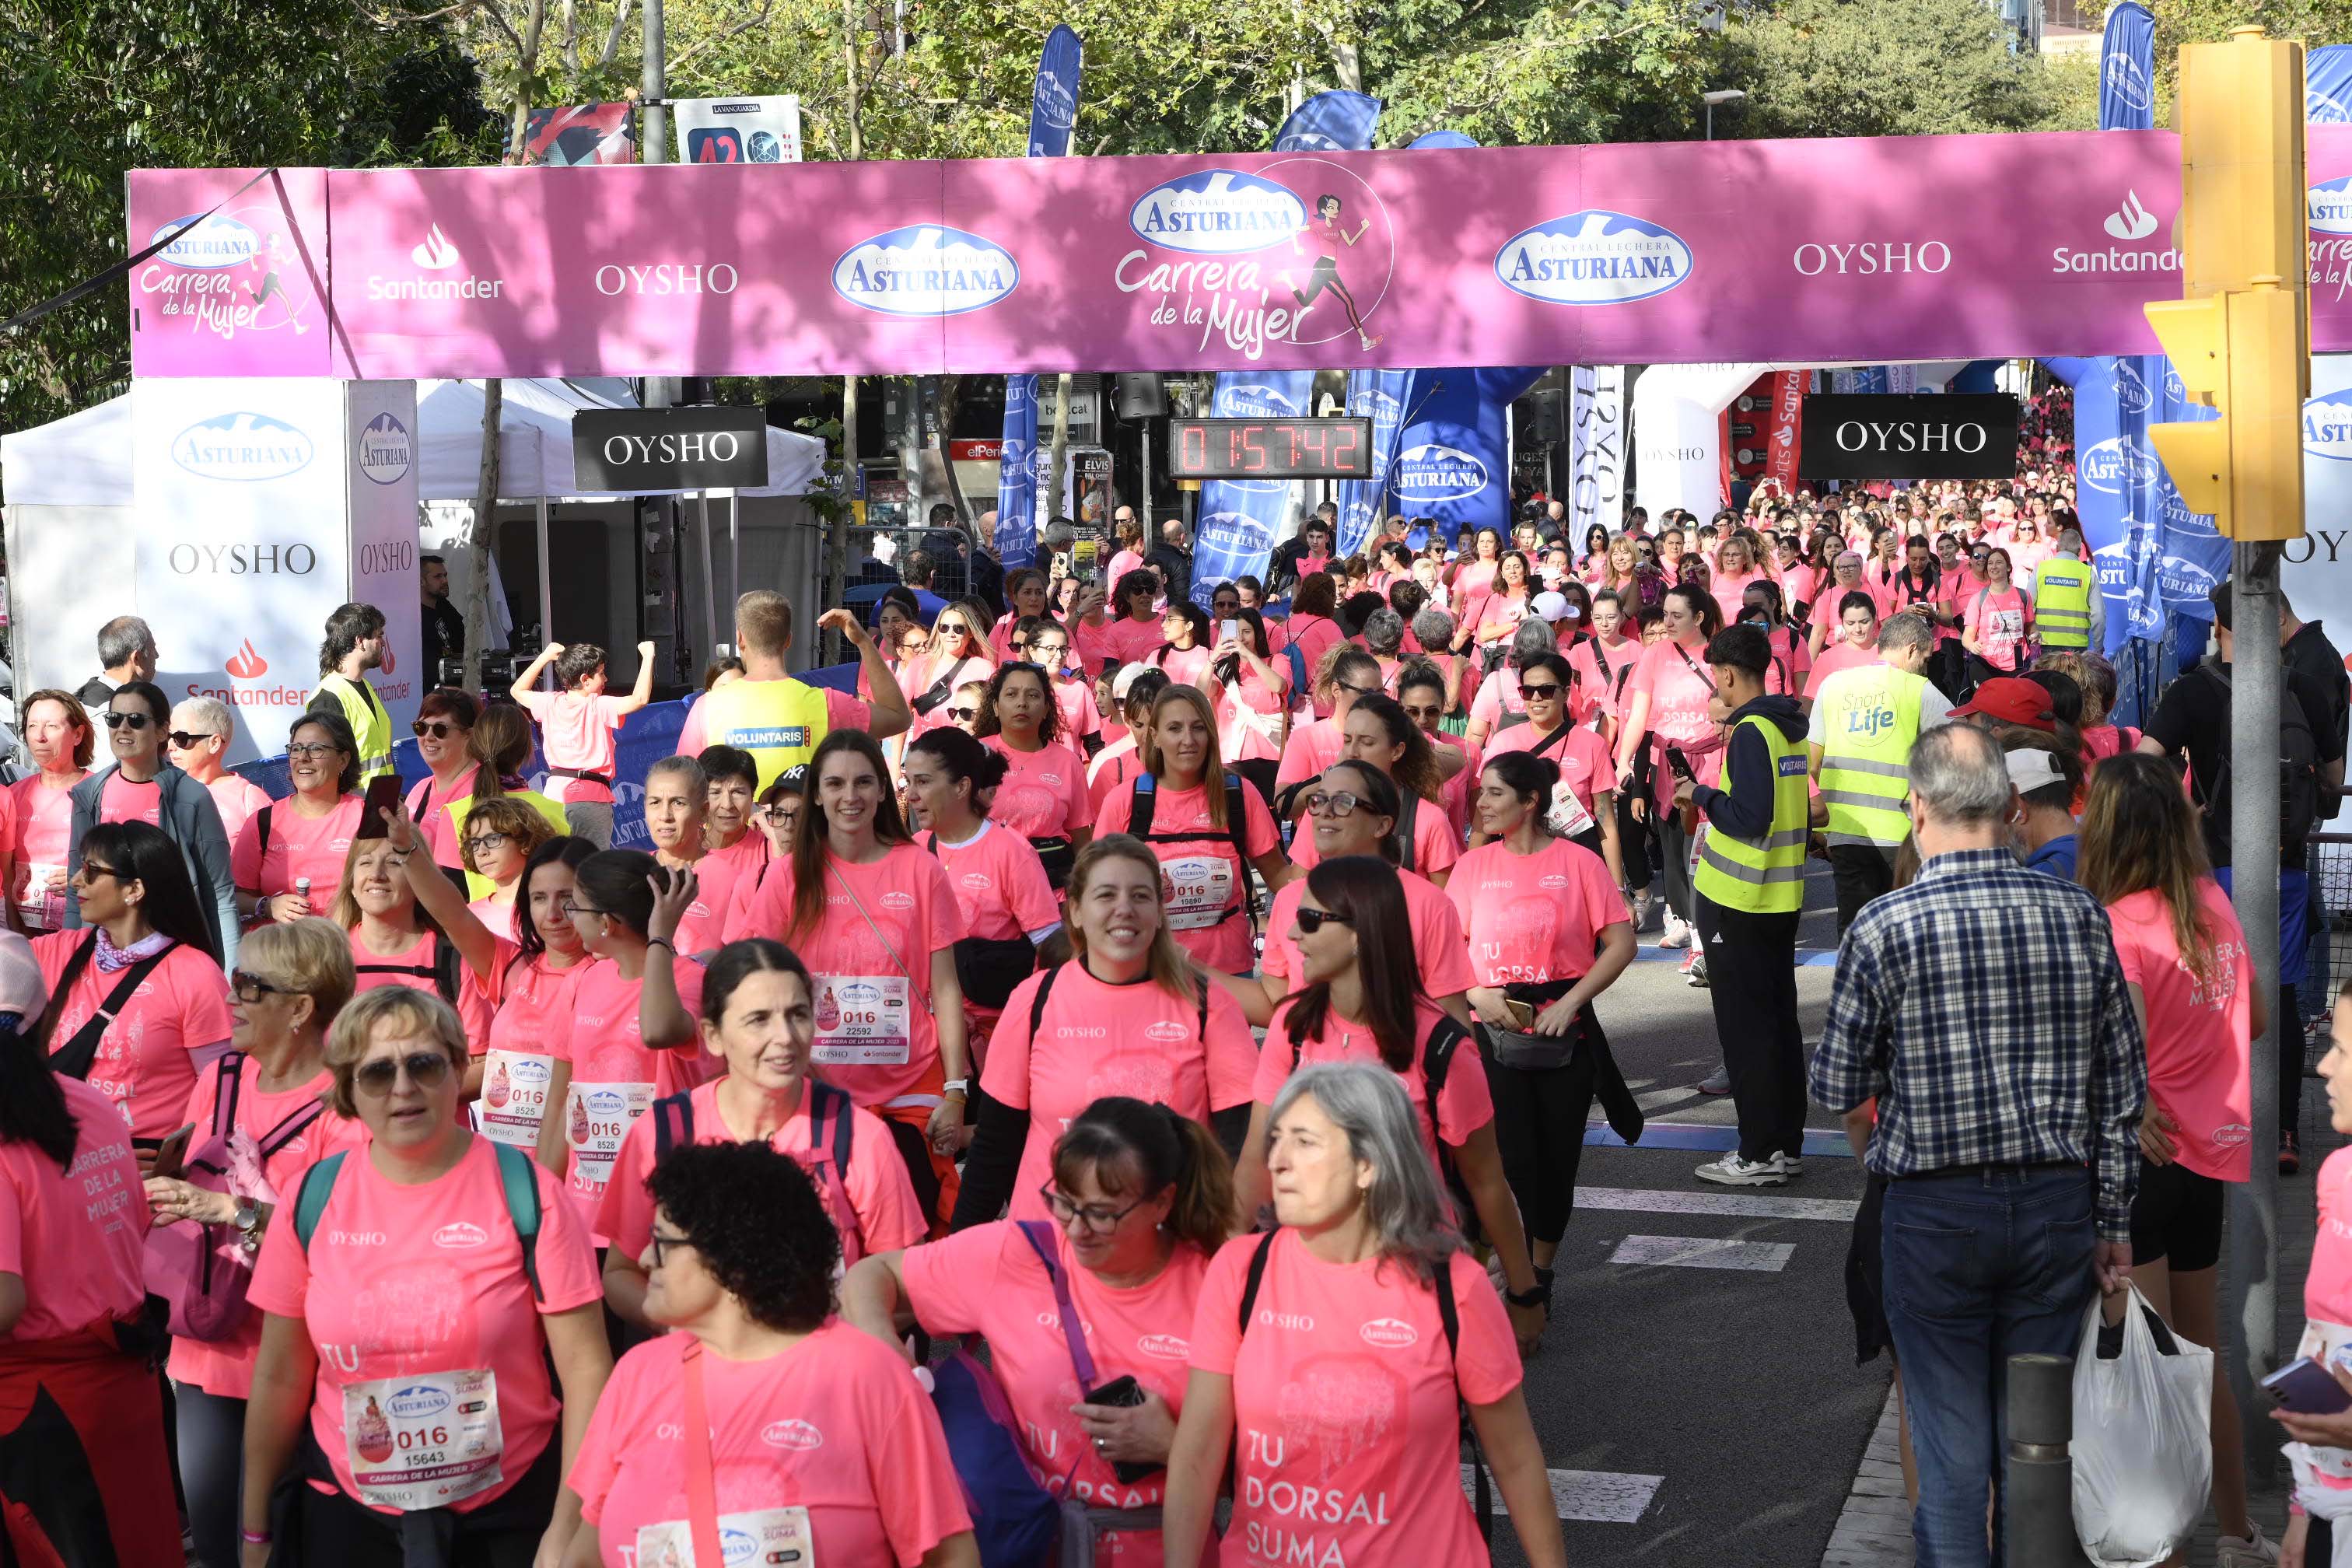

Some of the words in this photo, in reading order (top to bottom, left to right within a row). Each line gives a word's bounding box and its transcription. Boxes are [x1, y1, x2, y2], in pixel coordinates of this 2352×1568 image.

[1143, 201, 1293, 233] ASTURIANA
[1540, 243, 1600, 253] CENTRAL
[1606, 242, 1672, 251] LECHERA
[1793, 240, 1951, 275] OYSHO
[847, 258, 1006, 292] ASTURIANA
[1114, 249, 1260, 292] Carrera
[1508, 247, 1678, 282] ASTURIANA
[140, 264, 232, 293] Carrera
[367, 275, 503, 301] Santander
[594, 263, 738, 296] OYSHO
[163, 292, 180, 315] de
[182, 292, 196, 316] la
[193, 291, 267, 340] Mujer
[1150, 295, 1178, 325] de
[1183, 293, 1203, 325] la
[1199, 286, 1315, 361] Mujer
[1182, 425, 1356, 470] 01:57:42
[1836, 421, 1986, 453] OYSHO
[183, 437, 303, 464] ASTURIANA
[362, 446, 408, 467] ASTURIANA
[604, 432, 739, 465] OYSHO
[1644, 446, 1704, 461] OYSHO
[1085, 460, 1109, 471] ELVIS
[1437, 463, 1478, 471] LECHERA
[1393, 467, 1482, 489] ASTURIANA
[1199, 522, 1270, 551] ASTURIANA
[169, 543, 317, 575] OYSHO
[360, 540, 412, 576] OYSHO
[1843, 690, 1886, 710] Sport
[1848, 705, 1895, 737] Life
[726, 732, 802, 745] VOLUNTARIS
[271, 843, 303, 852] OYSHO
[1178, 885, 1205, 897] 016
[1181, 897, 1202, 905] 19890
[1481, 941, 1500, 961] TU
[842, 991, 878, 999] ASTURIANA
[843, 1011, 876, 1024] 016
[845, 1027, 872, 1036] 22592
[1056, 1027, 1107, 1040] OYSHO
[514, 1068, 548, 1079] ASTURIANA
[512, 1089, 543, 1104] 016
[589, 1098, 623, 1109] ASTURIANA
[515, 1106, 536, 1115] 8525
[488, 1127, 514, 1138] OYSHO
[591, 1122, 621, 1136] 016
[597, 1141, 615, 1150] 8528
[83, 1174, 104, 1197] DE
[105, 1170, 123, 1190] LA
[86, 1190, 130, 1223] MUJER
[329, 1231, 387, 1246] OYSHO
[1259, 1309, 1314, 1332] OYSHO
[320, 1343, 360, 1374] TU
[391, 1398, 446, 1413] ASTURIANA
[397, 1426, 448, 1450] 016
[1027, 1420, 1058, 1460] TU
[1248, 1430, 1285, 1468] TU
[404, 1451, 446, 1467] 15643
[369, 1472, 410, 1484] CARRERA
[411, 1469, 425, 1480] DE
[426, 1468, 437, 1478] LA
[1247, 1475, 1392, 1527] DORSAL
[1247, 1521, 1346, 1568] SUMA
